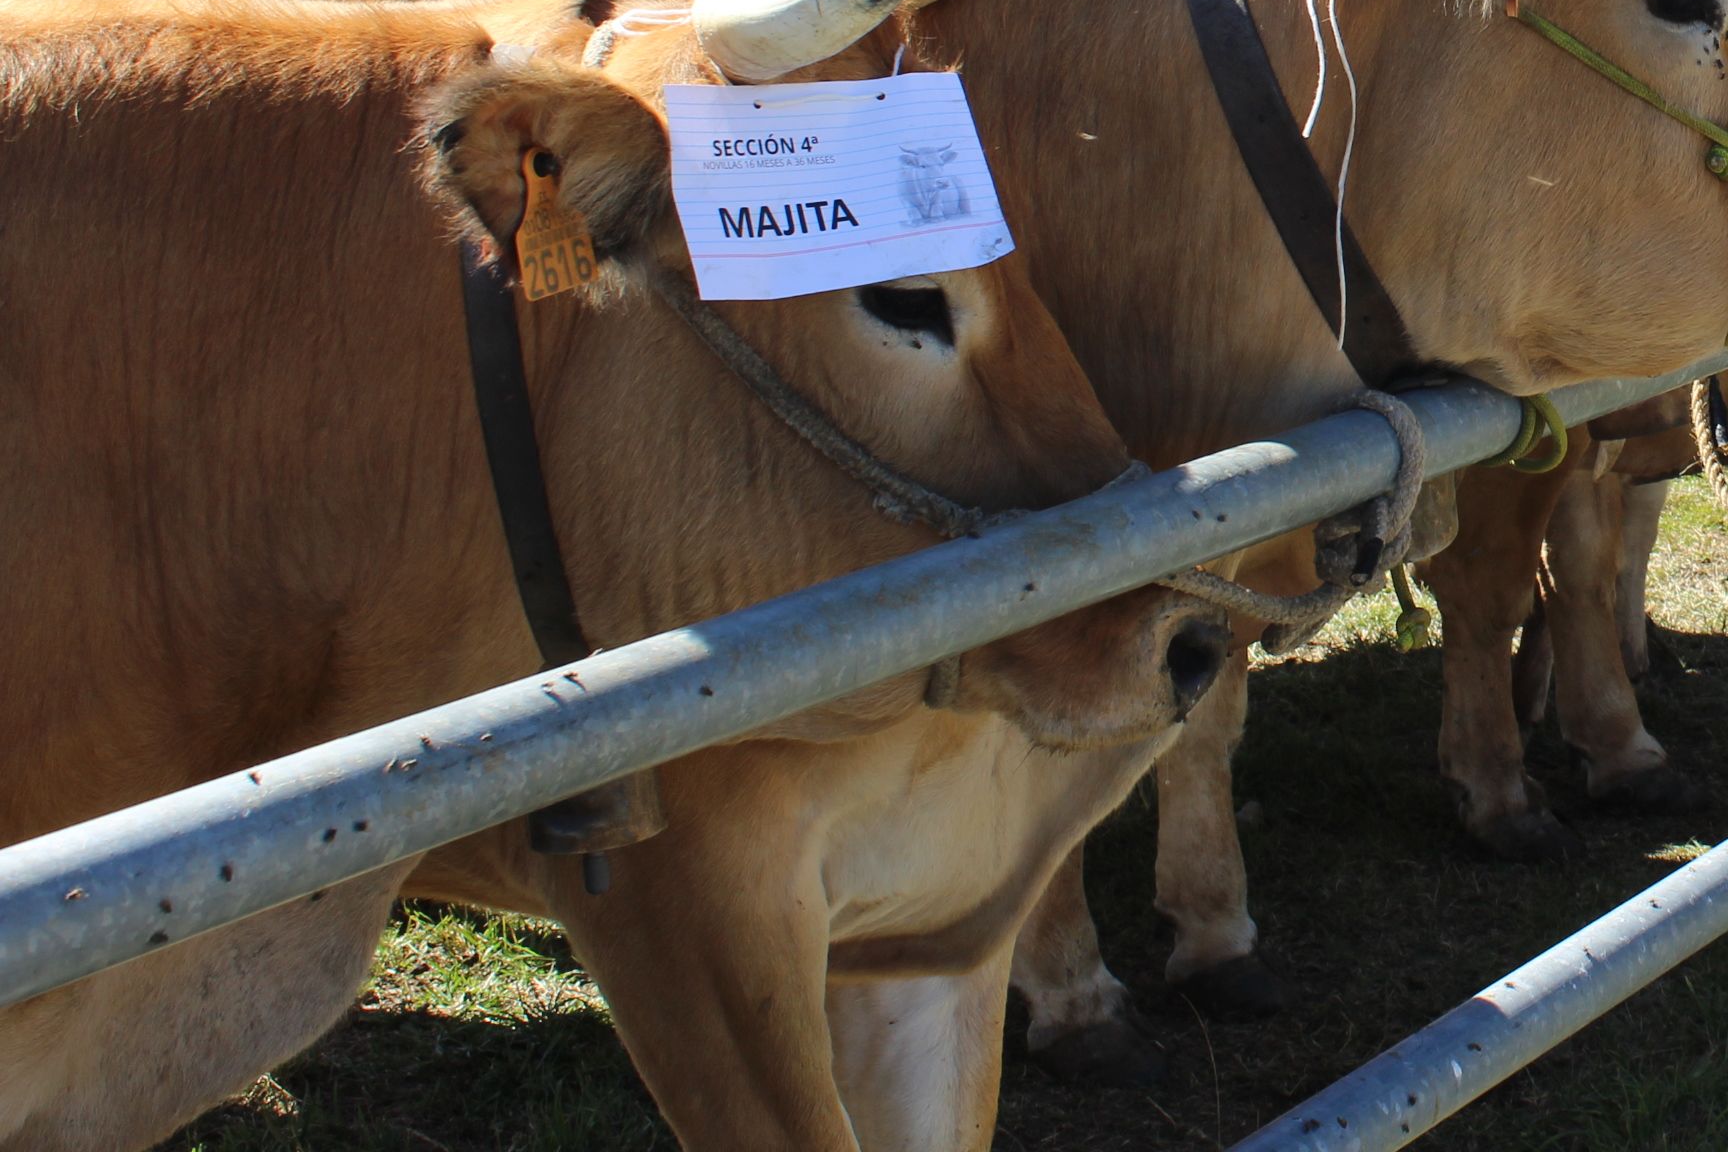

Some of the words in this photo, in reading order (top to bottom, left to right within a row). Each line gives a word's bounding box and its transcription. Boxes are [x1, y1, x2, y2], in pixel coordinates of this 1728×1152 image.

[713, 133, 795, 157] SECCIÓN
[801, 136, 819, 152] 4ª
[703, 160, 743, 170] NOVILLAS
[756, 158, 785, 168] MESES
[786, 158, 793, 167] A
[807, 155, 836, 166] MESES
[718, 199, 859, 238] MAJITA
[524, 239, 593, 299] 2616
